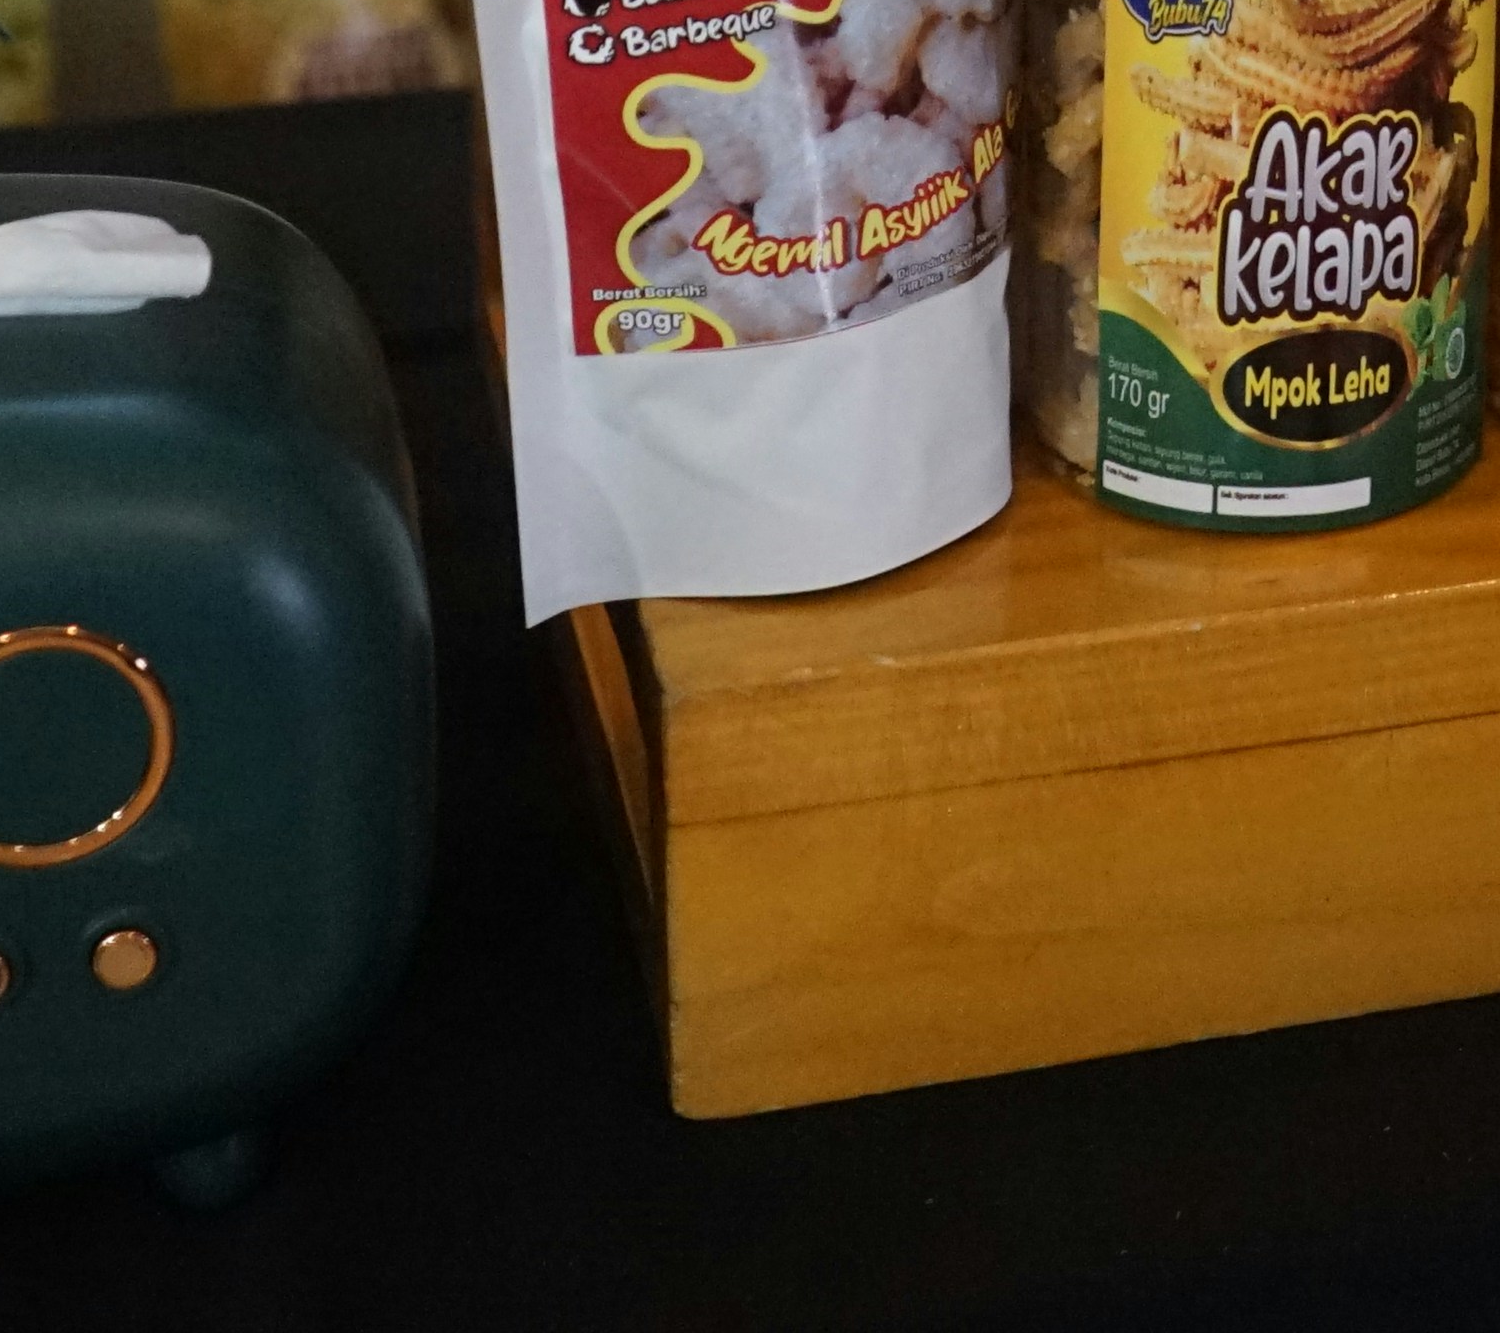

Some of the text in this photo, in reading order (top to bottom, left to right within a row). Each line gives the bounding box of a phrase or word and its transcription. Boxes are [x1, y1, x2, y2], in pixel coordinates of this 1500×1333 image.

[620, 4, 777, 60] Barbeque
[696, 209, 846, 275] Ngemil
[973, 124, 1004, 184] Ala
[1225, 206, 1416, 317] kelapa
[592, 284, 707, 302] Berat Bersih:
[617, 309, 686, 335] 90gr
[1108, 372, 1171, 419] 170 gr
[1244, 359, 1392, 420] Mpok Leha
